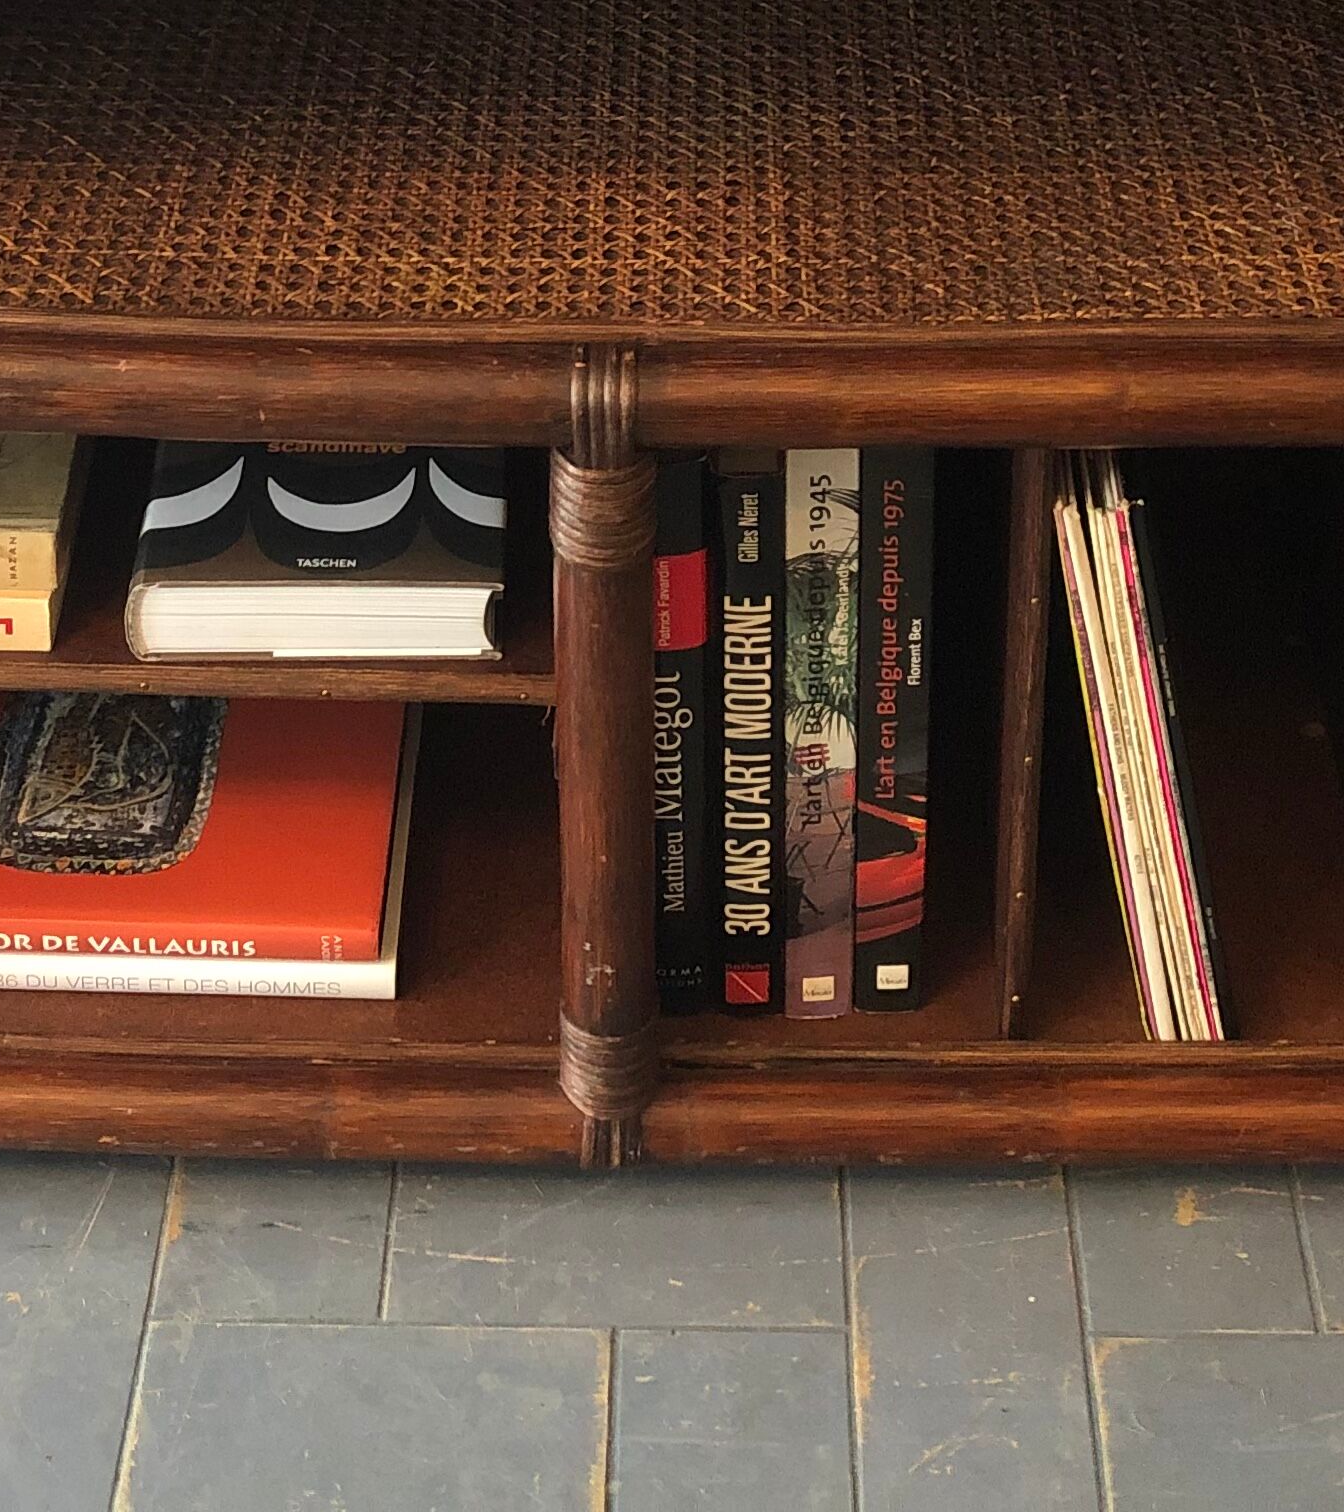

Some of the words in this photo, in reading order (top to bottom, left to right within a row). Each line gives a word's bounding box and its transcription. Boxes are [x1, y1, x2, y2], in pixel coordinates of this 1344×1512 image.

[737, 492, 759, 527] Néret
[809, 474, 832, 531] 1945
[883, 479, 905, 529] 1975
[296, 558, 357, 568] TASCHEN
[737, 530, 759, 563] Gilles
[657, 560, 670, 606] Favardin
[877, 535, 904, 612] depuis
[658, 609, 671, 647] Patrick
[908, 618, 923, 640] Bex
[723, 595, 772, 739] MODERNE
[800, 630, 830, 735] Belgique
[875, 617, 903, 715] Belgique
[907, 643, 922, 686] Florent
[880, 720, 899, 749] en
[806, 743, 823, 771] en
[875, 755, 896, 799] L'art
[724, 747, 772, 830] D'ART
[661, 831, 685, 912] Mathieu
[724, 839, 771, 895] ANS
[723, 903, 771, 936] 30
[41, 935, 80, 953] DE
[87, 936, 257, 957] VALLAURIS
[25, 974, 58, 989] DU
[65, 975, 141, 991] VERRE
[148, 977, 175, 992] ET
[183, 979, 229, 993] DES
[238, 980, 342, 996] HOMMES
